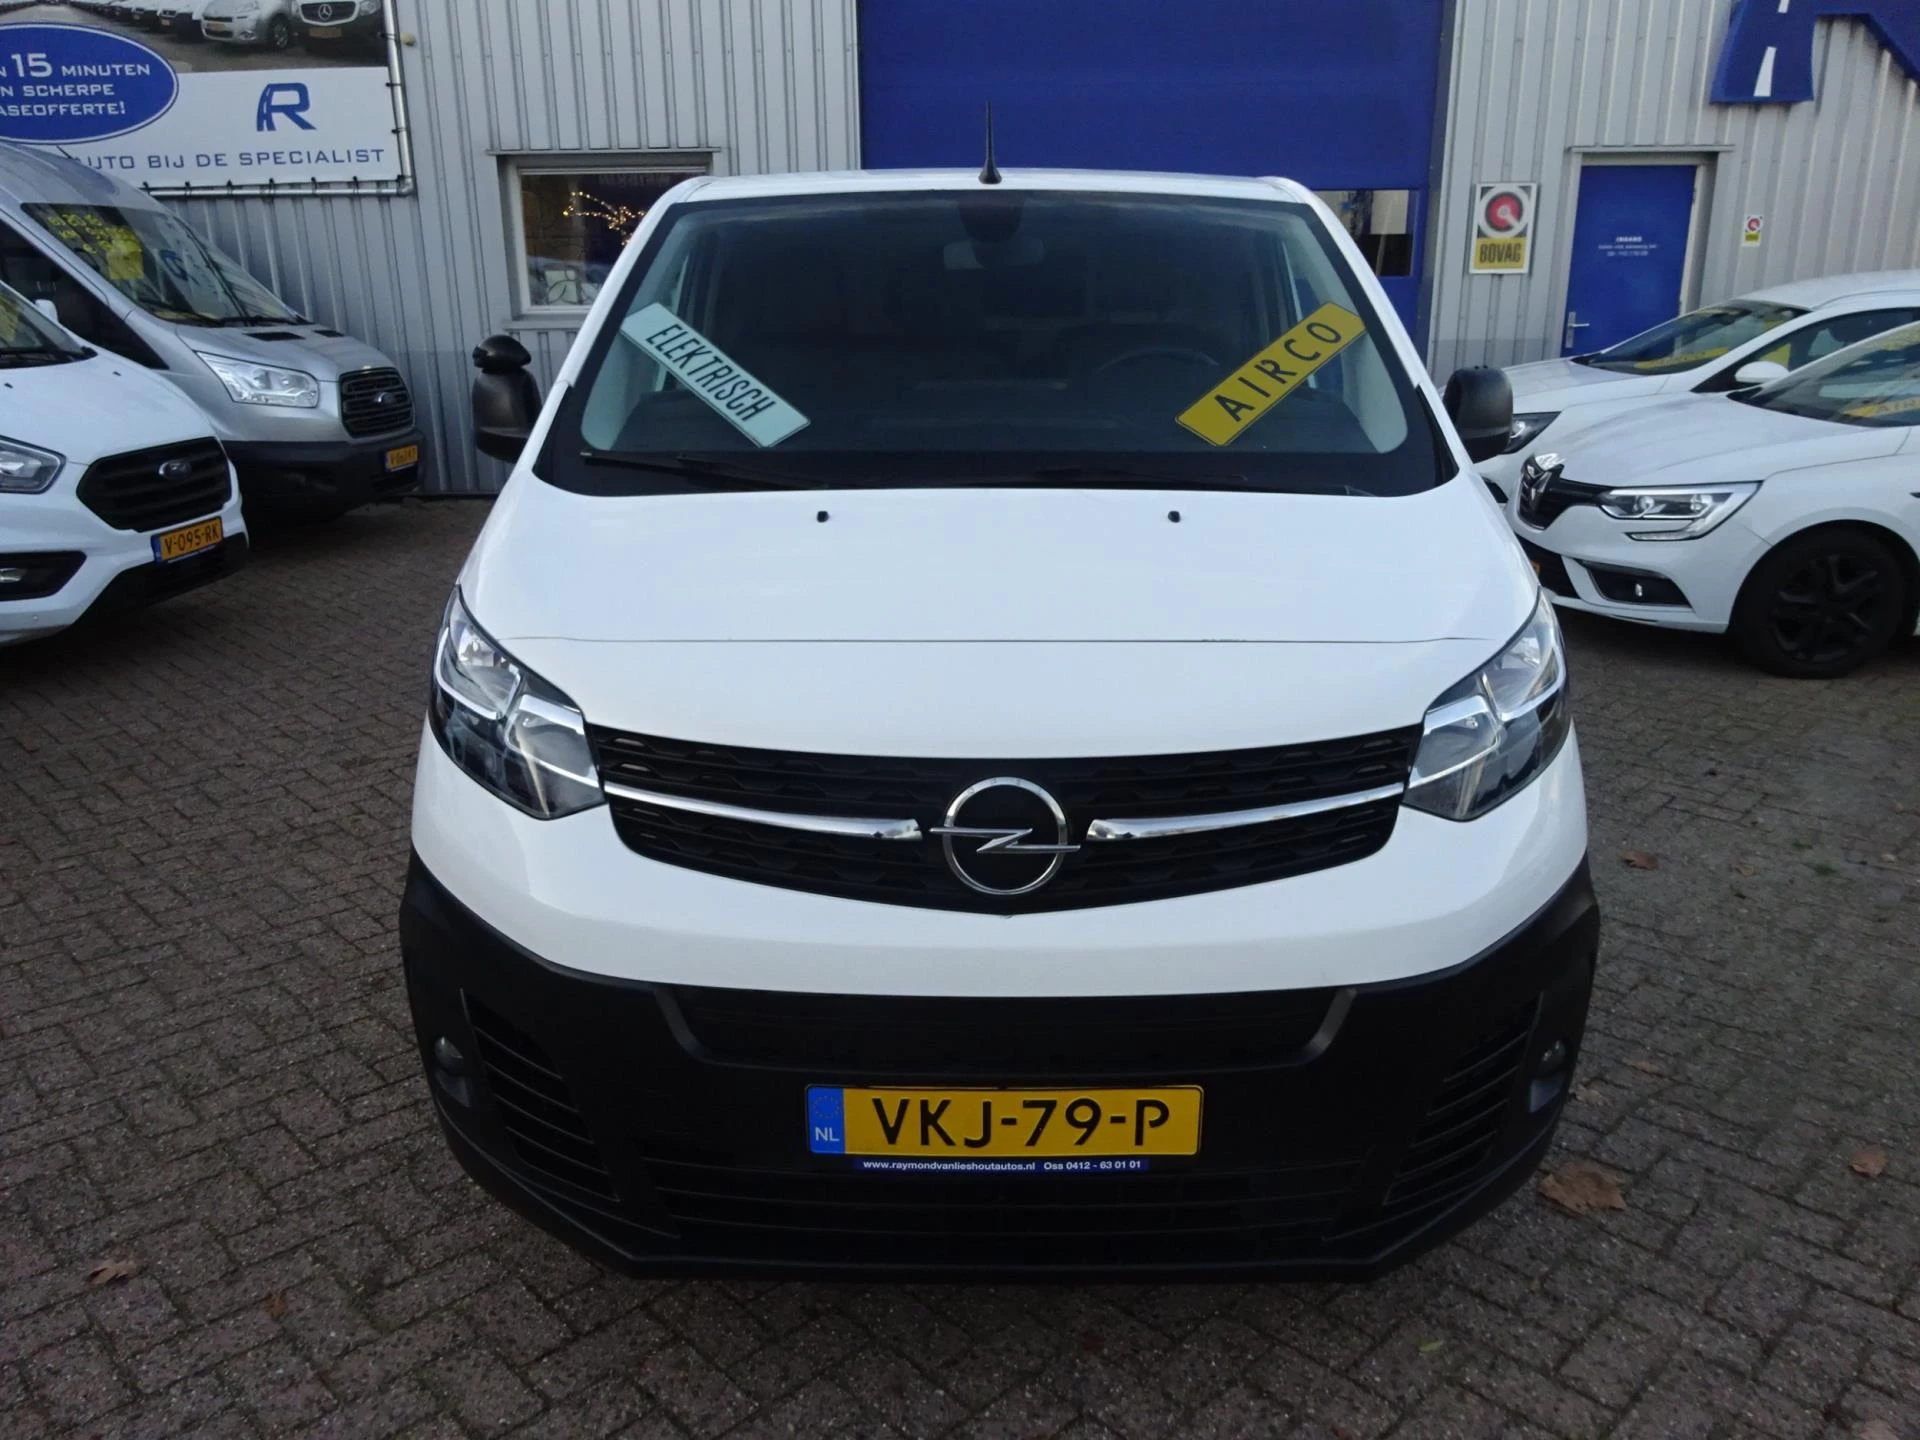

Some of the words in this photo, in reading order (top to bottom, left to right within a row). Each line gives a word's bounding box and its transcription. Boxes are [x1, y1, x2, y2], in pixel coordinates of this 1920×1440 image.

[11, 53, 53, 77] 15
[61, 64, 151, 77] MINUTEN
[22, 83, 115, 97] SCHERPE
[74, 155, 135, 169] UTO
[147, 153, 185, 169] BIJ
[195, 153, 229, 168] DE
[239, 148, 385, 166] SPECIALIST
[1479, 242, 1522, 263] BOVAG
[645, 323, 776, 422] ELEKTRISCH
[1214, 322, 1342, 423] AIRCO
[871, 1097, 1171, 1149] VKJ-79-P
[814, 1126, 840, 1142] NL
[863, 1160, 1036, 1171] www.raymondvanlieshoutautos.nl
[1043, 1162, 1064, 1170] Oss
[1066, 1161, 1090, 1170] 0412
[1099, 1160, 1112, 1169] 63
[1114, 1160, 1127, 1169] 01
[1129, 1160, 1141, 1169] 01
